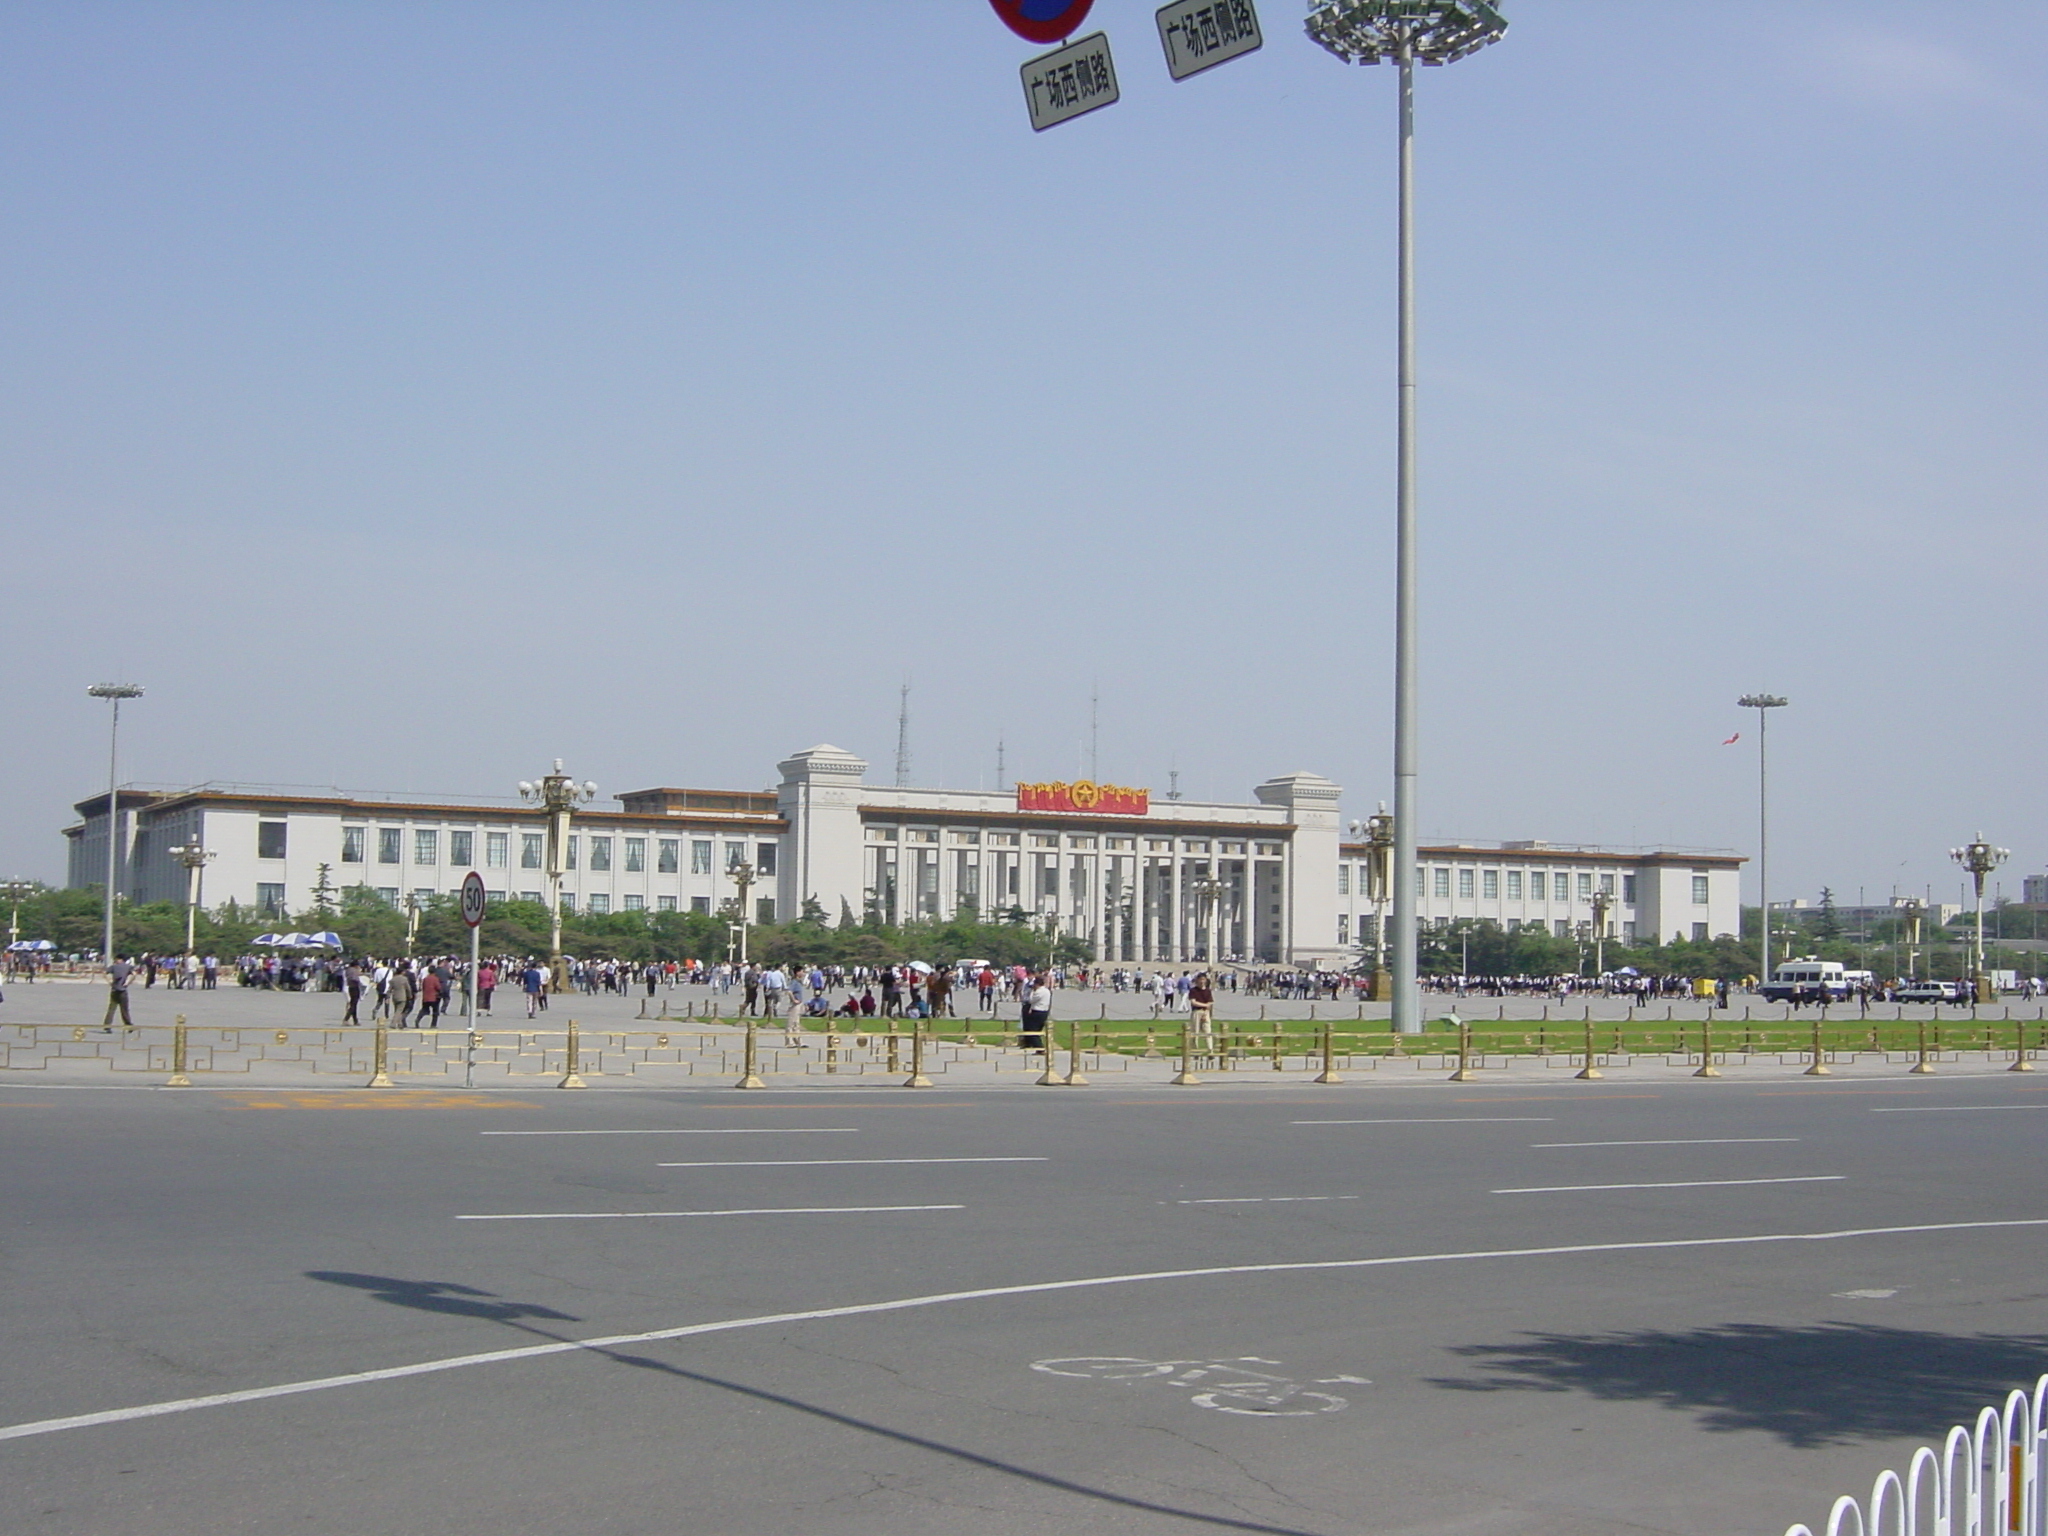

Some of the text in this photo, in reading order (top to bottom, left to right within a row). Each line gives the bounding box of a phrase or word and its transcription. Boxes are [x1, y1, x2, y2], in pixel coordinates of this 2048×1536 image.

[1166, 0, 1254, 66] 广场西侧路
[1031, 50, 1110, 116] 广场西侧路
[466, 887, 480, 912] 50
